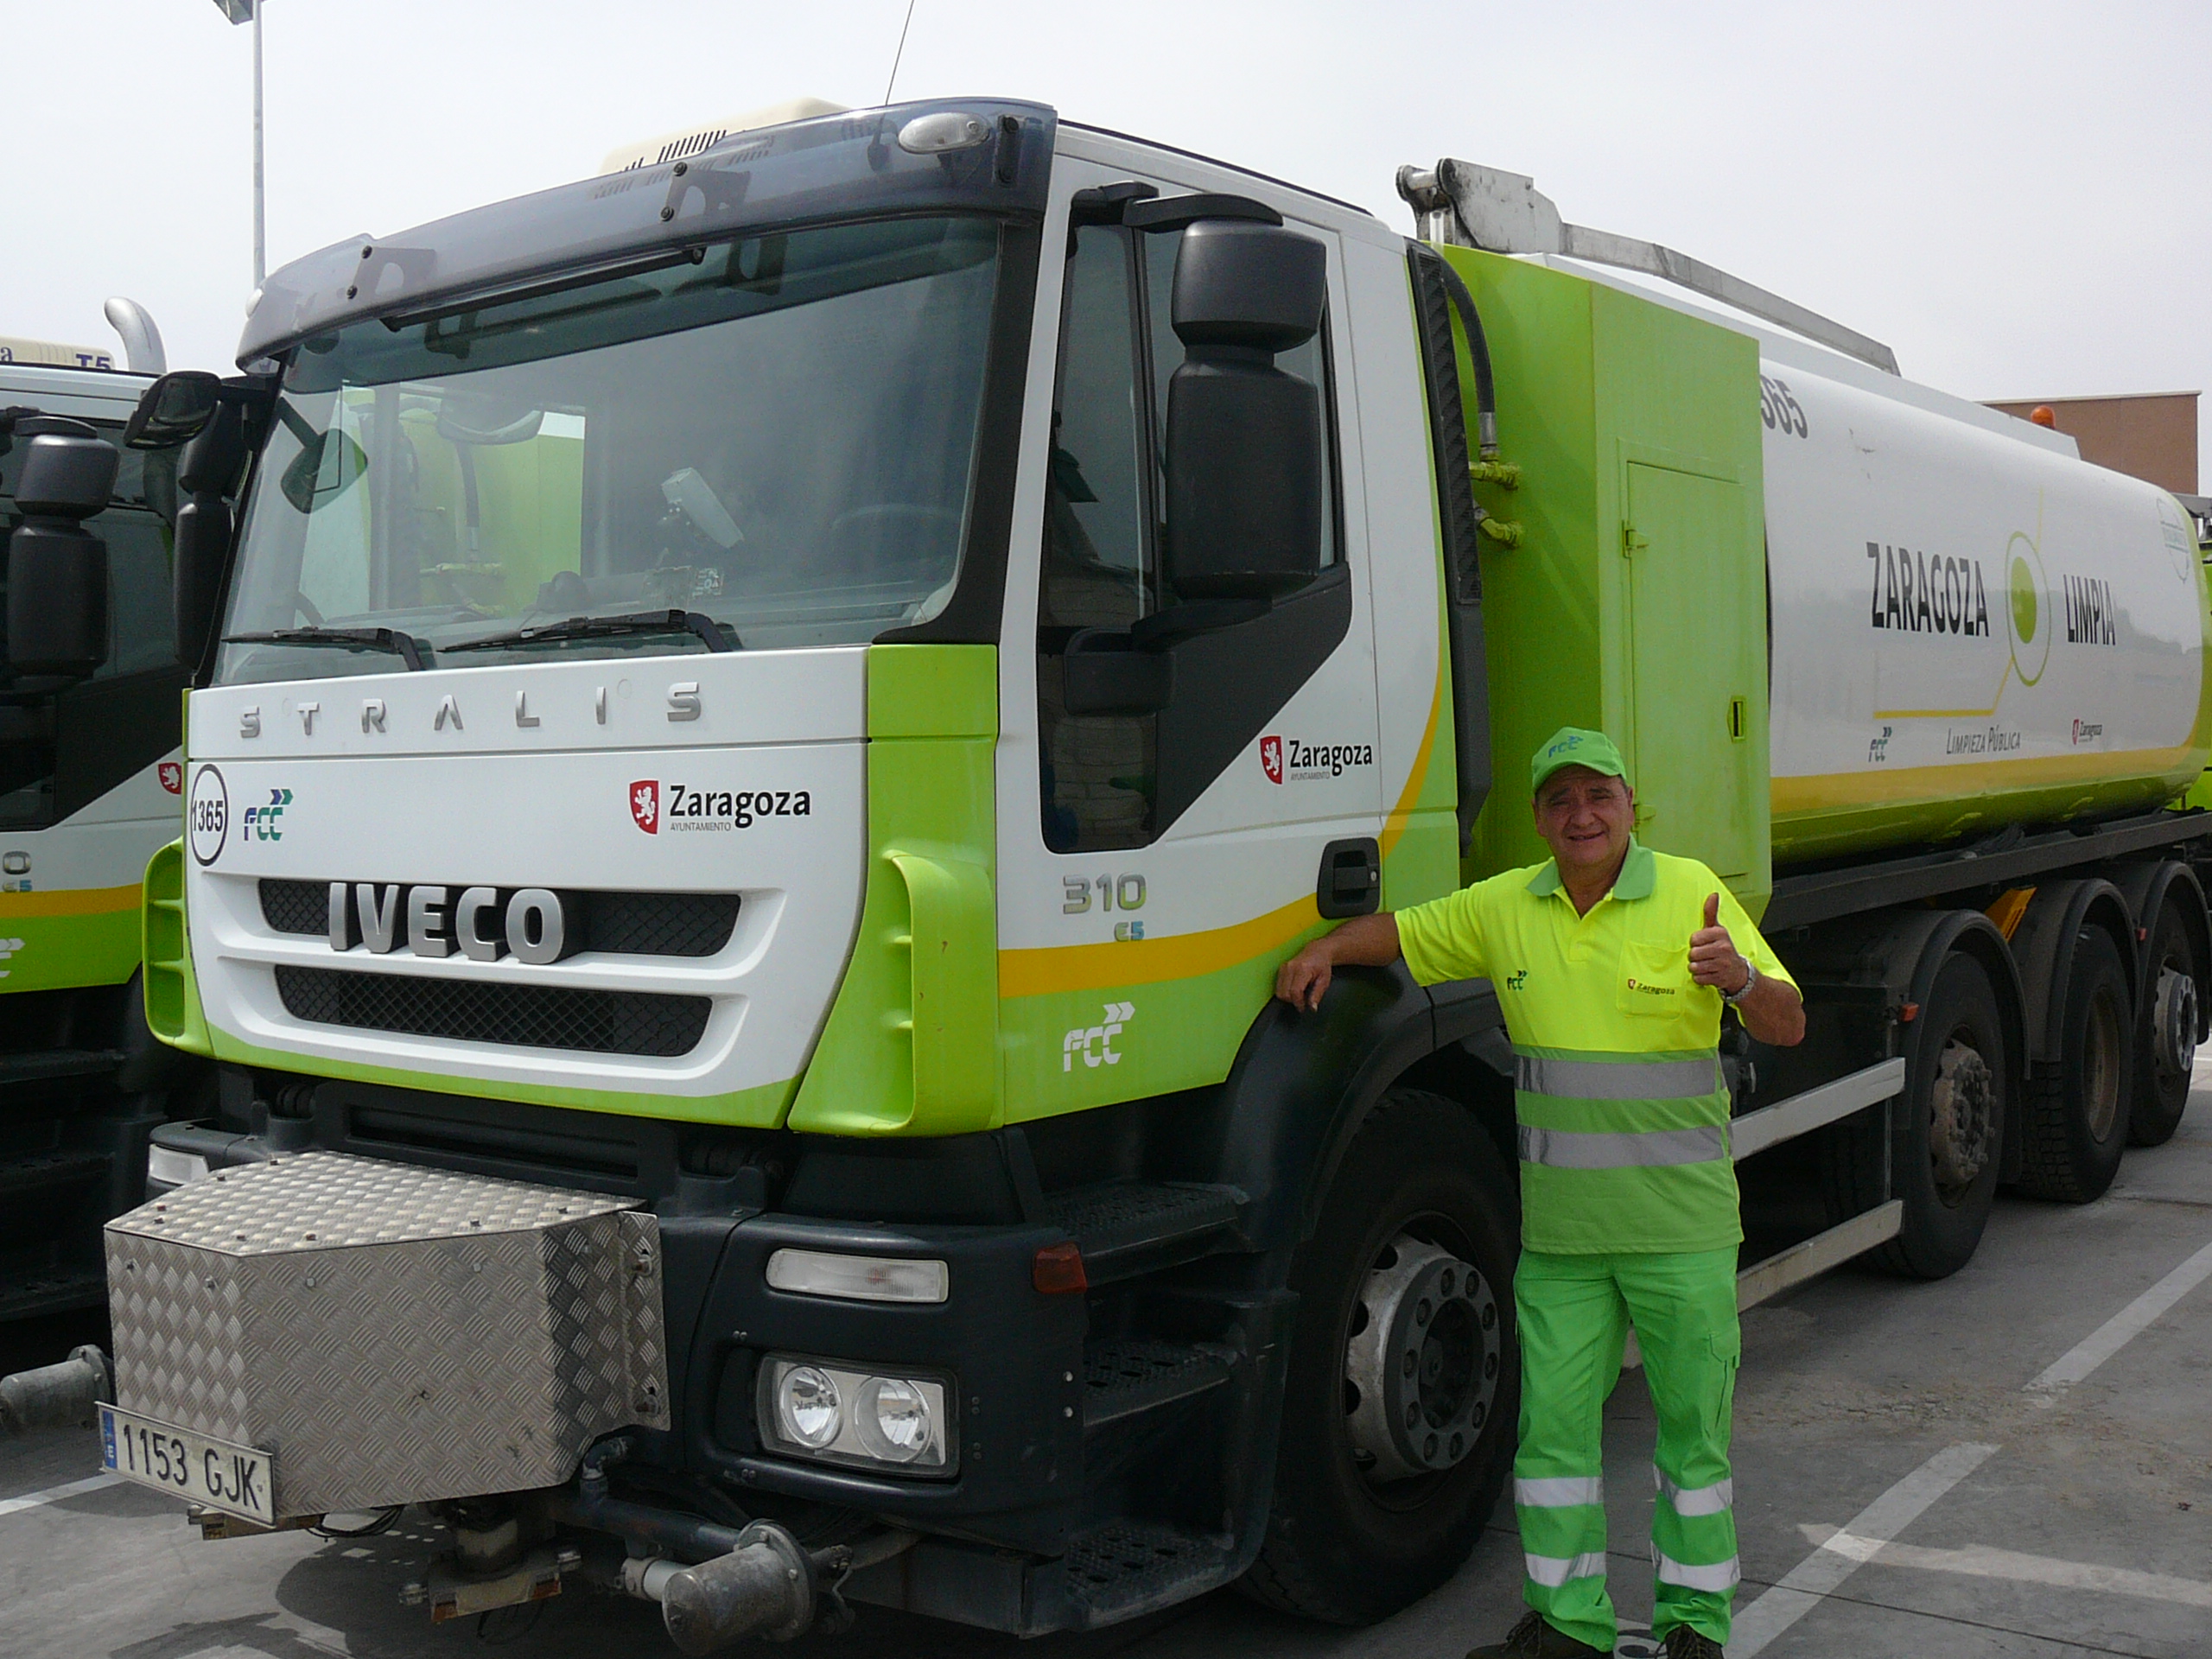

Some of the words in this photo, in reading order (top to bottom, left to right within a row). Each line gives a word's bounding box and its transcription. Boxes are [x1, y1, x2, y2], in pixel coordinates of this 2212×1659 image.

[1866, 542, 1989, 638] ZARAGOZA
[2063, 574, 2116, 645] LIMPIA
[240, 682, 702, 738] STRALIS
[1289, 740, 1372, 777] Zaragoza
[1290, 772, 1331, 781] AYUNTAMIENTO
[193, 800, 224, 832] 1365
[244, 807, 283, 841] FCC
[670, 785, 810, 829] Zaragoza
[671, 822, 731, 831] AYUNTAMIENTO
[1063, 872, 1147, 915] 310
[328, 882, 565, 965] IVECO
[1114, 921, 1145, 942] E5
[1064, 1023, 1122, 1072] FCC
[107, 1445, 115, 1459] E
[124, 1424, 188, 1486] 1153
[204, 1448, 259, 1510] GJK
